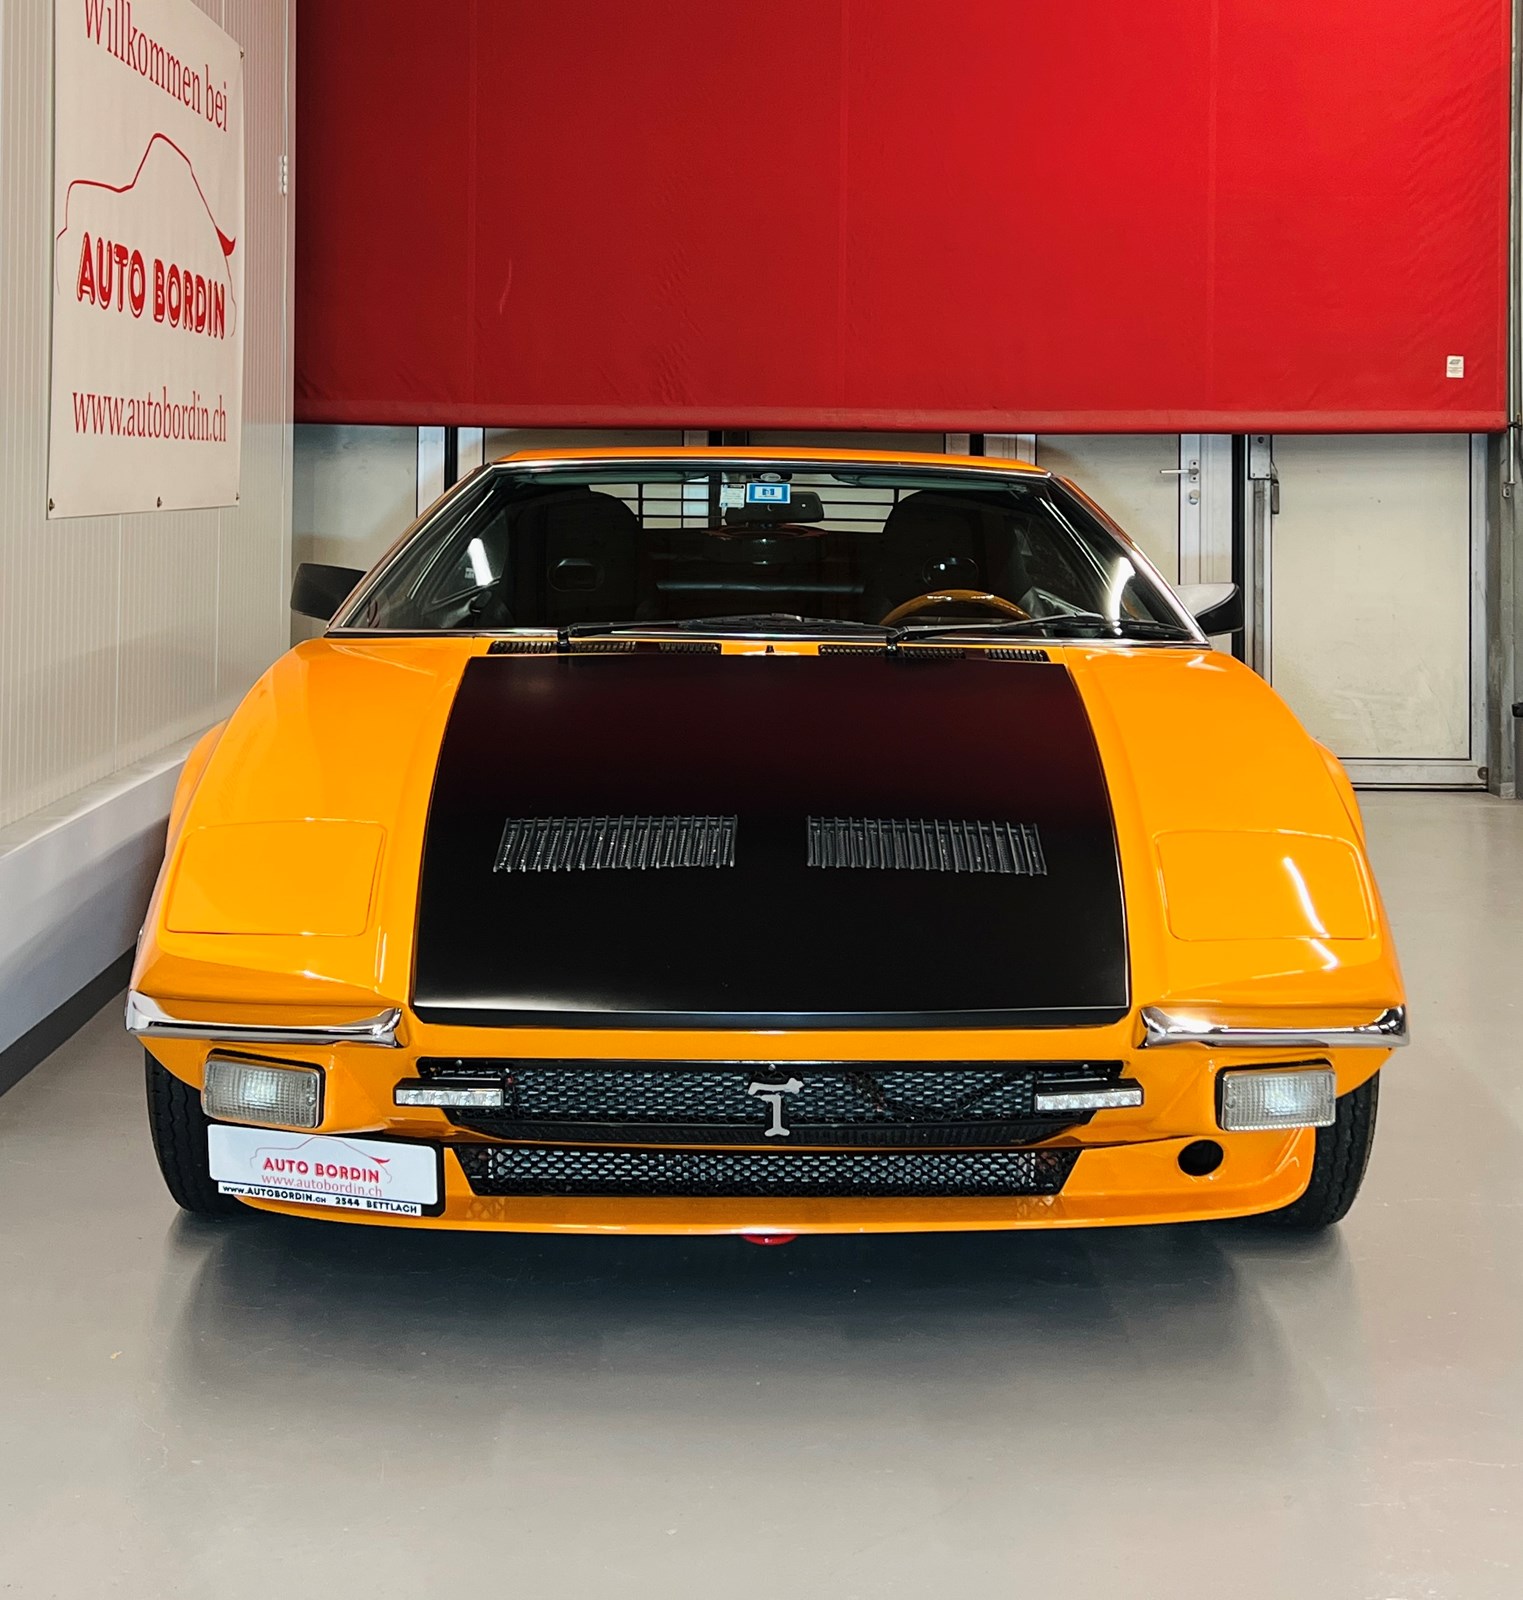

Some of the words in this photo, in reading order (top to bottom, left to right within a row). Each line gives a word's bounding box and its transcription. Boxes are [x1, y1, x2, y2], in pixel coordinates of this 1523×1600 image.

[205, 64, 227, 132] bei
[77, 232, 146, 318] AUTO
[153, 259, 225, 340] BORDIN
[72, 386, 227, 442] www.autobordin.ch
[261, 1173, 383, 1198] www.autobordin.ch
[263, 1157, 309, 1174] AUTO
[314, 1163, 380, 1183] BORDIN
[335, 1196, 360, 1207] 2544
[366, 1200, 417, 1214] BETTLACH
